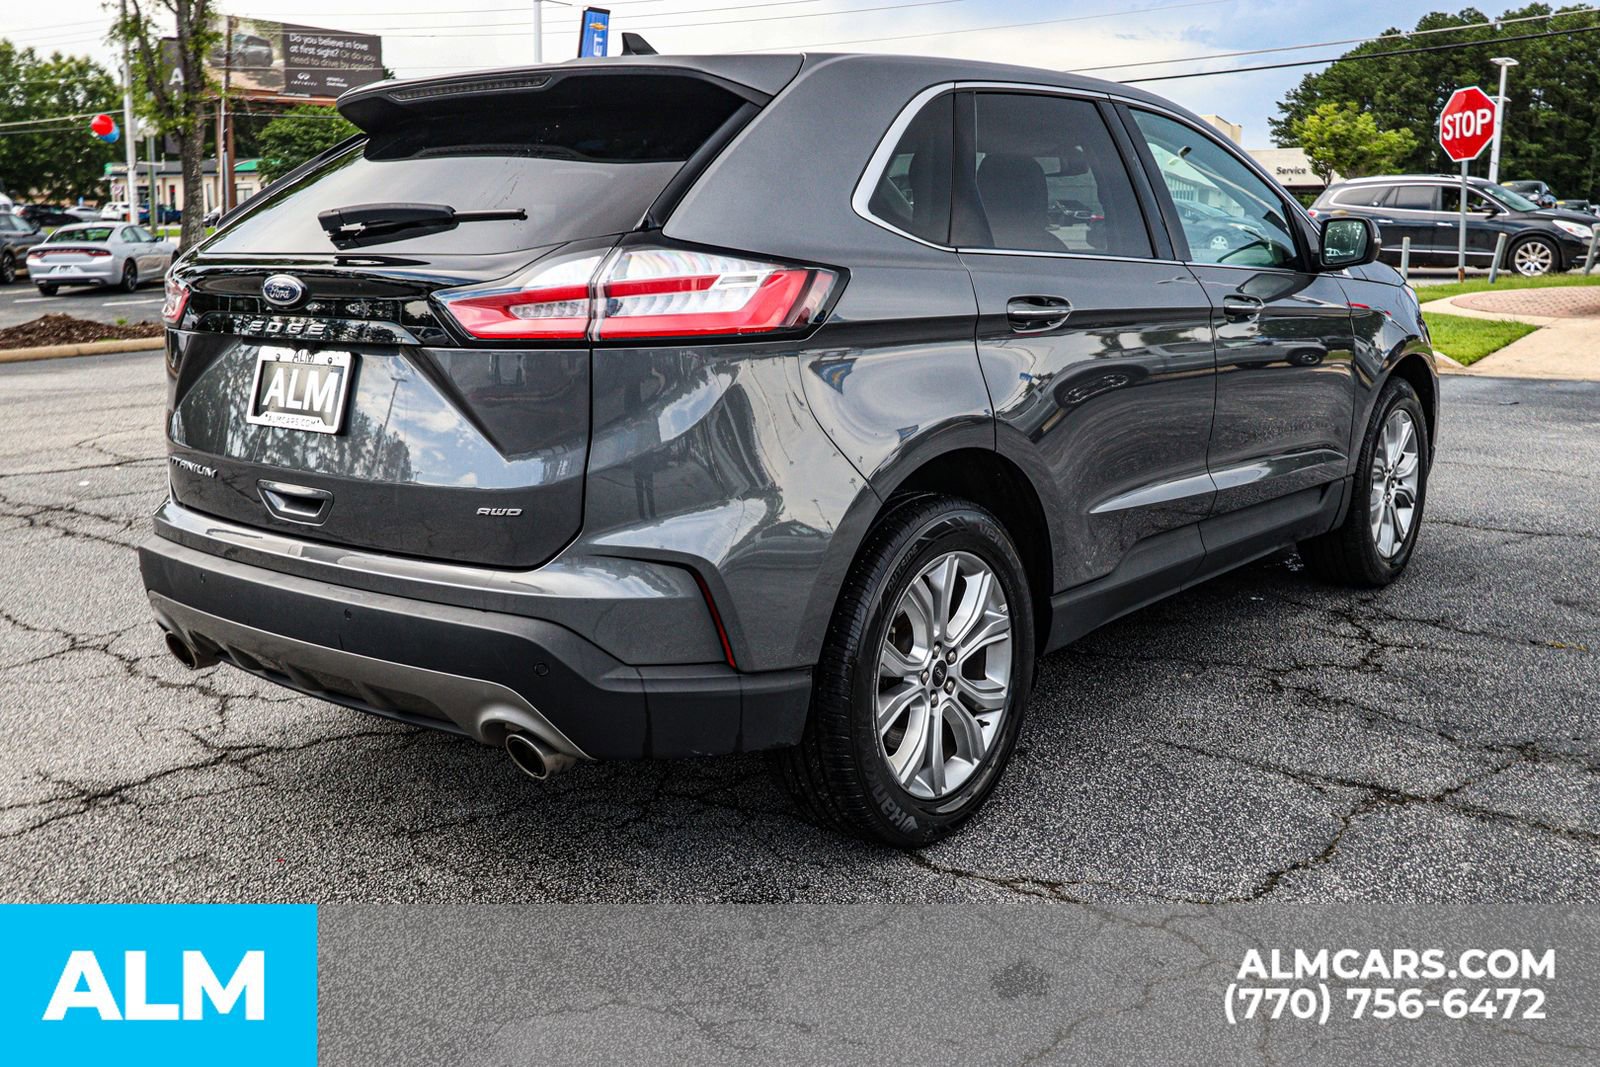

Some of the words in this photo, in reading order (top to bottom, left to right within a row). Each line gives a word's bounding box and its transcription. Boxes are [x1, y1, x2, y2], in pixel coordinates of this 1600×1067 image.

[289, 33, 301, 42] Do
[303, 37, 317, 45] you
[318, 36, 343, 48] believe
[345, 40, 352, 48] in
[353, 41, 368, 51] love
[289, 45, 299, 53] at
[300, 44, 316, 55] first
[317, 47, 339, 58] sight?
[340, 50, 349, 58] Or
[351, 51, 361, 60] do
[363, 54, 376, 62] you
[290, 56, 310, 65] need
[311, 58, 320, 66] to
[320, 59, 339, 68] drive
[340, 60, 349, 70] by
[1443, 108, 1492, 141] STOP
[1276, 166, 1306, 175] Service
[269, 283, 291, 299] Ford
[249, 320, 326, 335] EDGE
[292, 350, 315, 363] ALM
[262, 367, 340, 413] ALM
[476, 507, 522, 516] AWD
